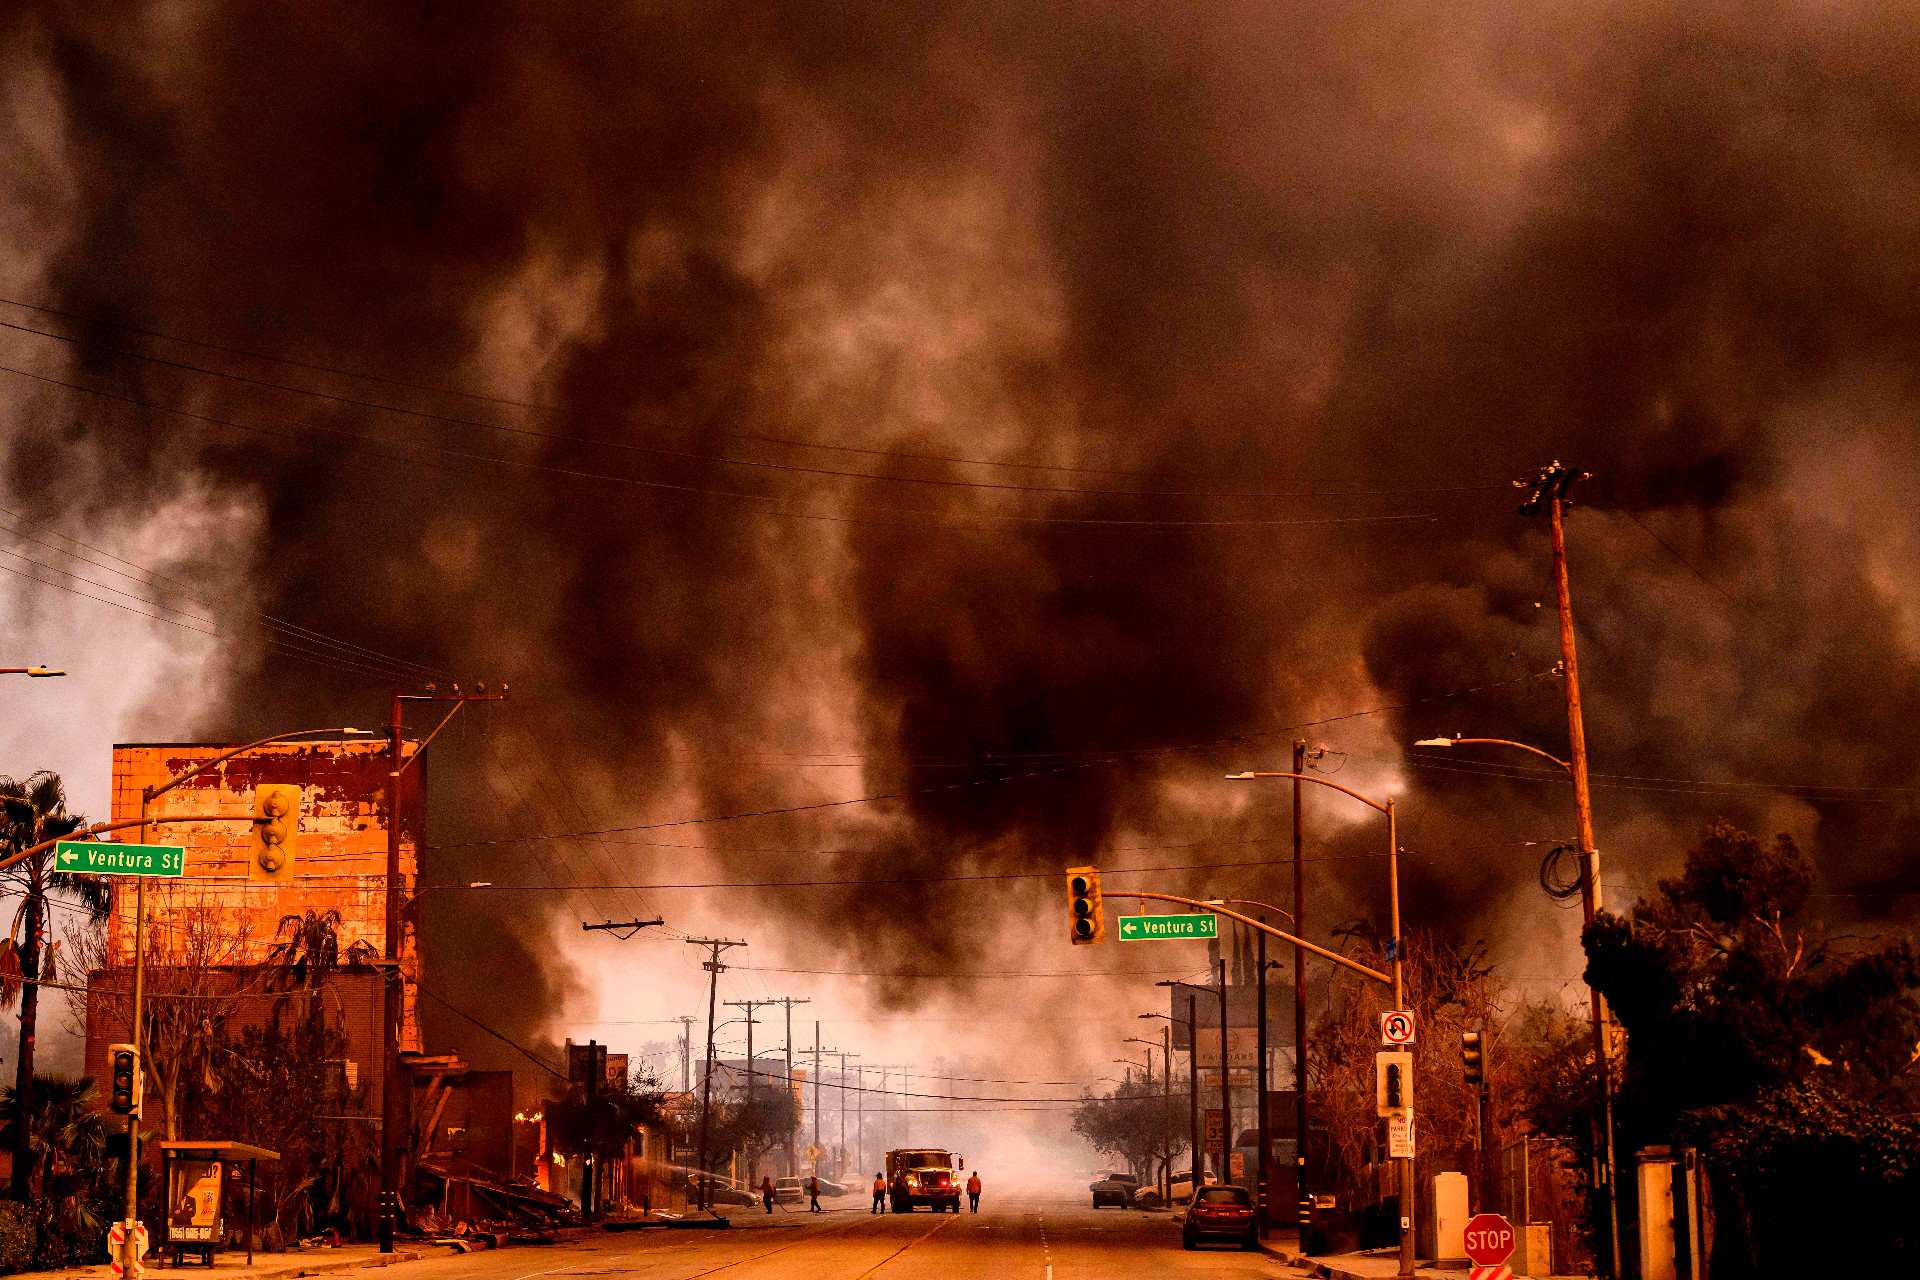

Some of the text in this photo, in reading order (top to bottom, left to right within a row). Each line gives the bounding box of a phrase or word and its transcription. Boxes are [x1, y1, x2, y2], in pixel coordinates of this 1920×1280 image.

[88, 849, 179, 869] Ventura St
[1143, 919, 1213, 934] Ventura St
[1467, 1230, 1511, 1250] STOP
